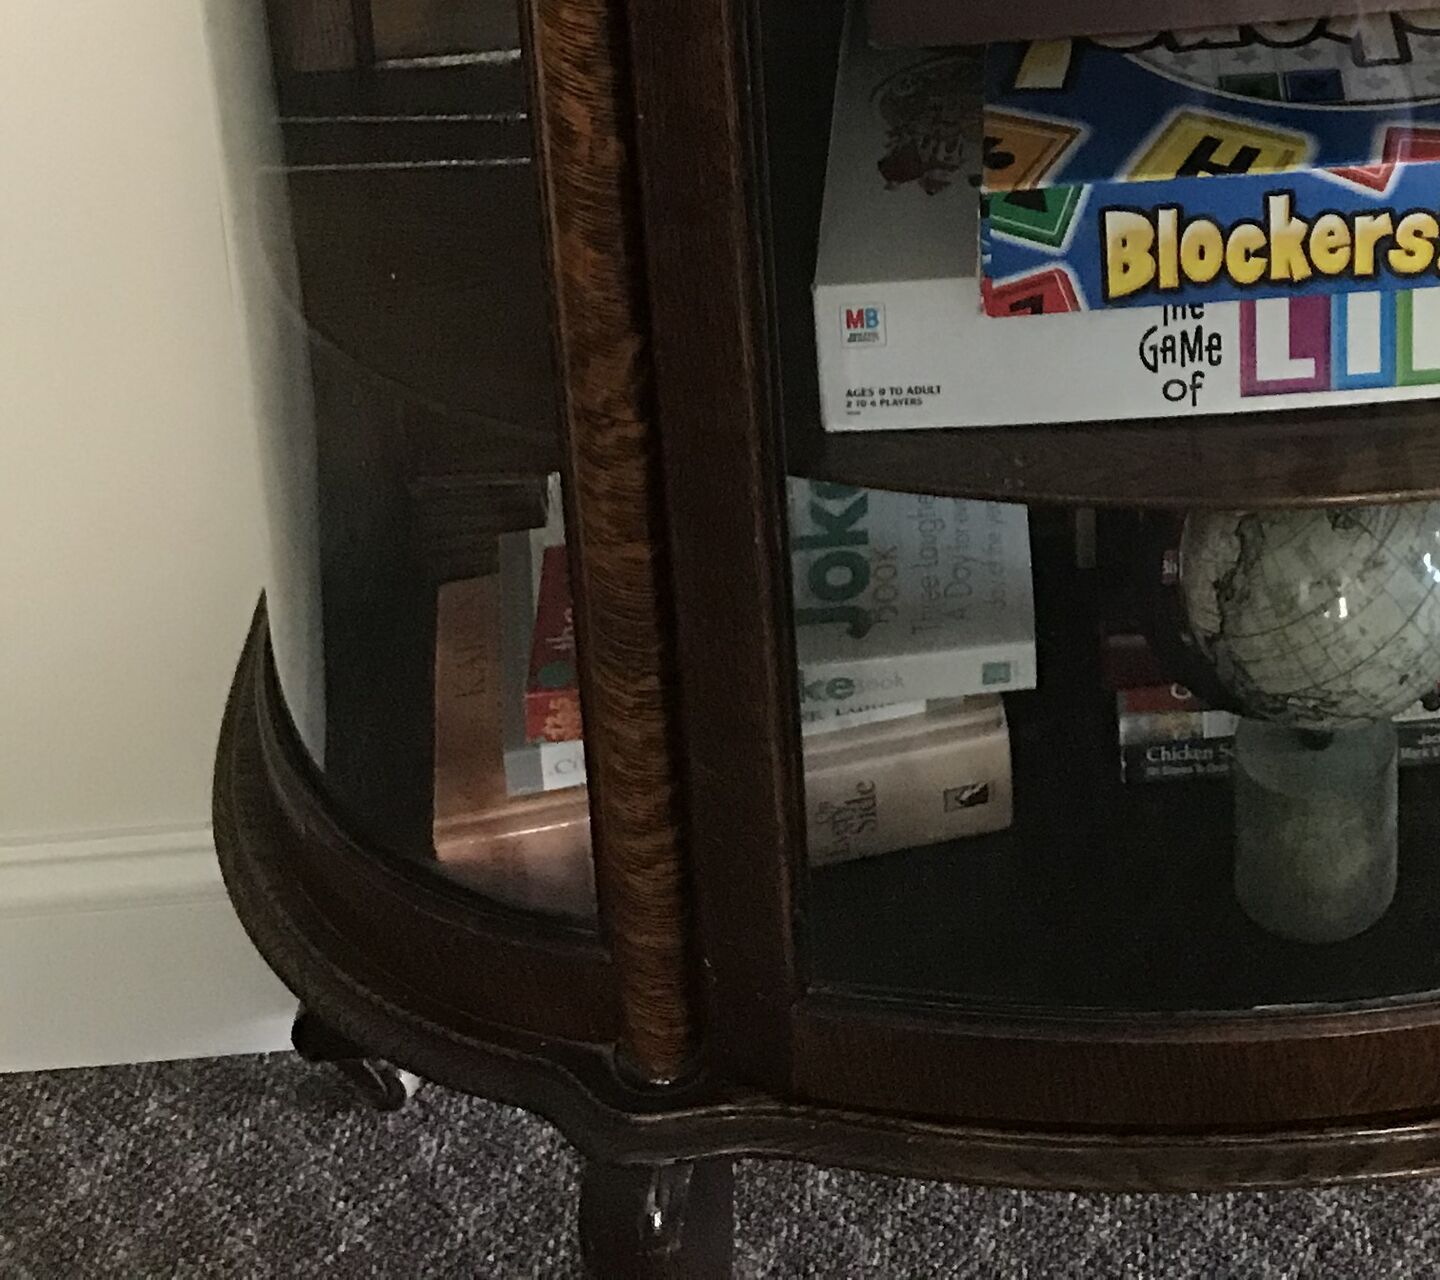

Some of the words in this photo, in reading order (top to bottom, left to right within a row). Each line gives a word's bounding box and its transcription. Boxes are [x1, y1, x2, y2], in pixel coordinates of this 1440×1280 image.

[845, 308, 880, 330] MB
[845, 389, 874, 398] AGES
[889, 386, 903, 396] TO
[906, 385, 941, 395] ADULT
[1162, 370, 1205, 407] of
[855, 400, 867, 408] TO
[879, 397, 923, 407] PLAYERS
[943, 553, 980, 598] Day
[1145, 743, 1214, 765] Chicken
